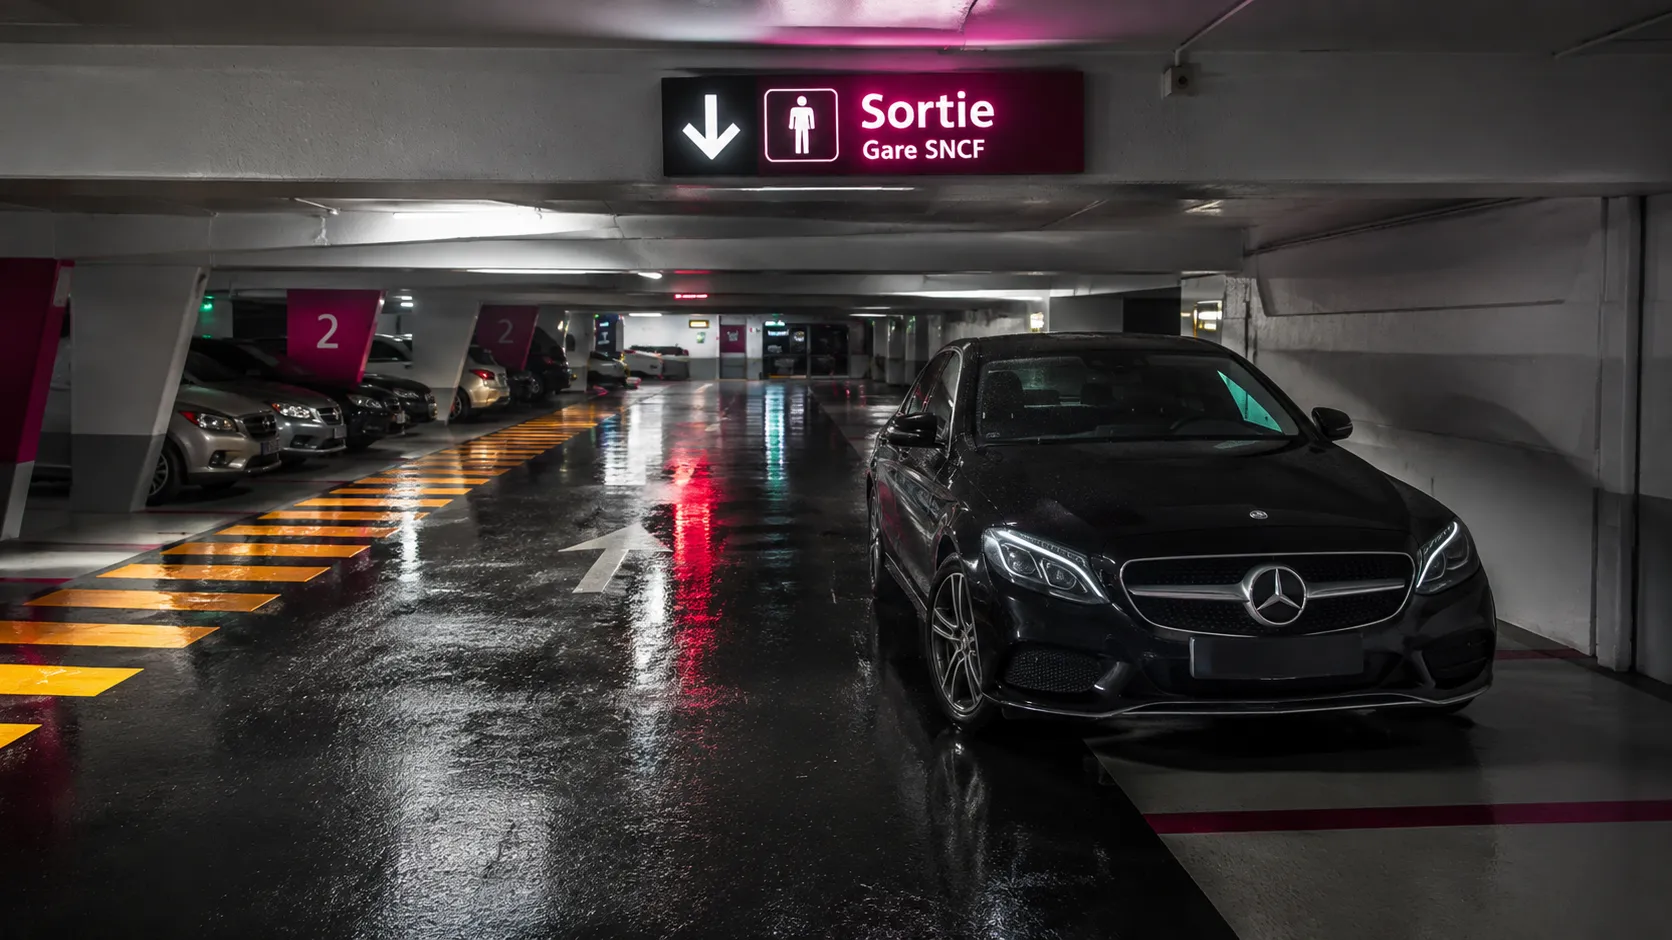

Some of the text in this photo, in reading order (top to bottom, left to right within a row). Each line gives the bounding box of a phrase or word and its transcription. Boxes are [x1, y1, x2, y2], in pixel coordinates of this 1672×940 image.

[861, 91, 995, 129] Sortie
[863, 139, 985, 160] Gare SNCF
[316, 313, 339, 349] 2
[497, 318, 515, 344] 2
